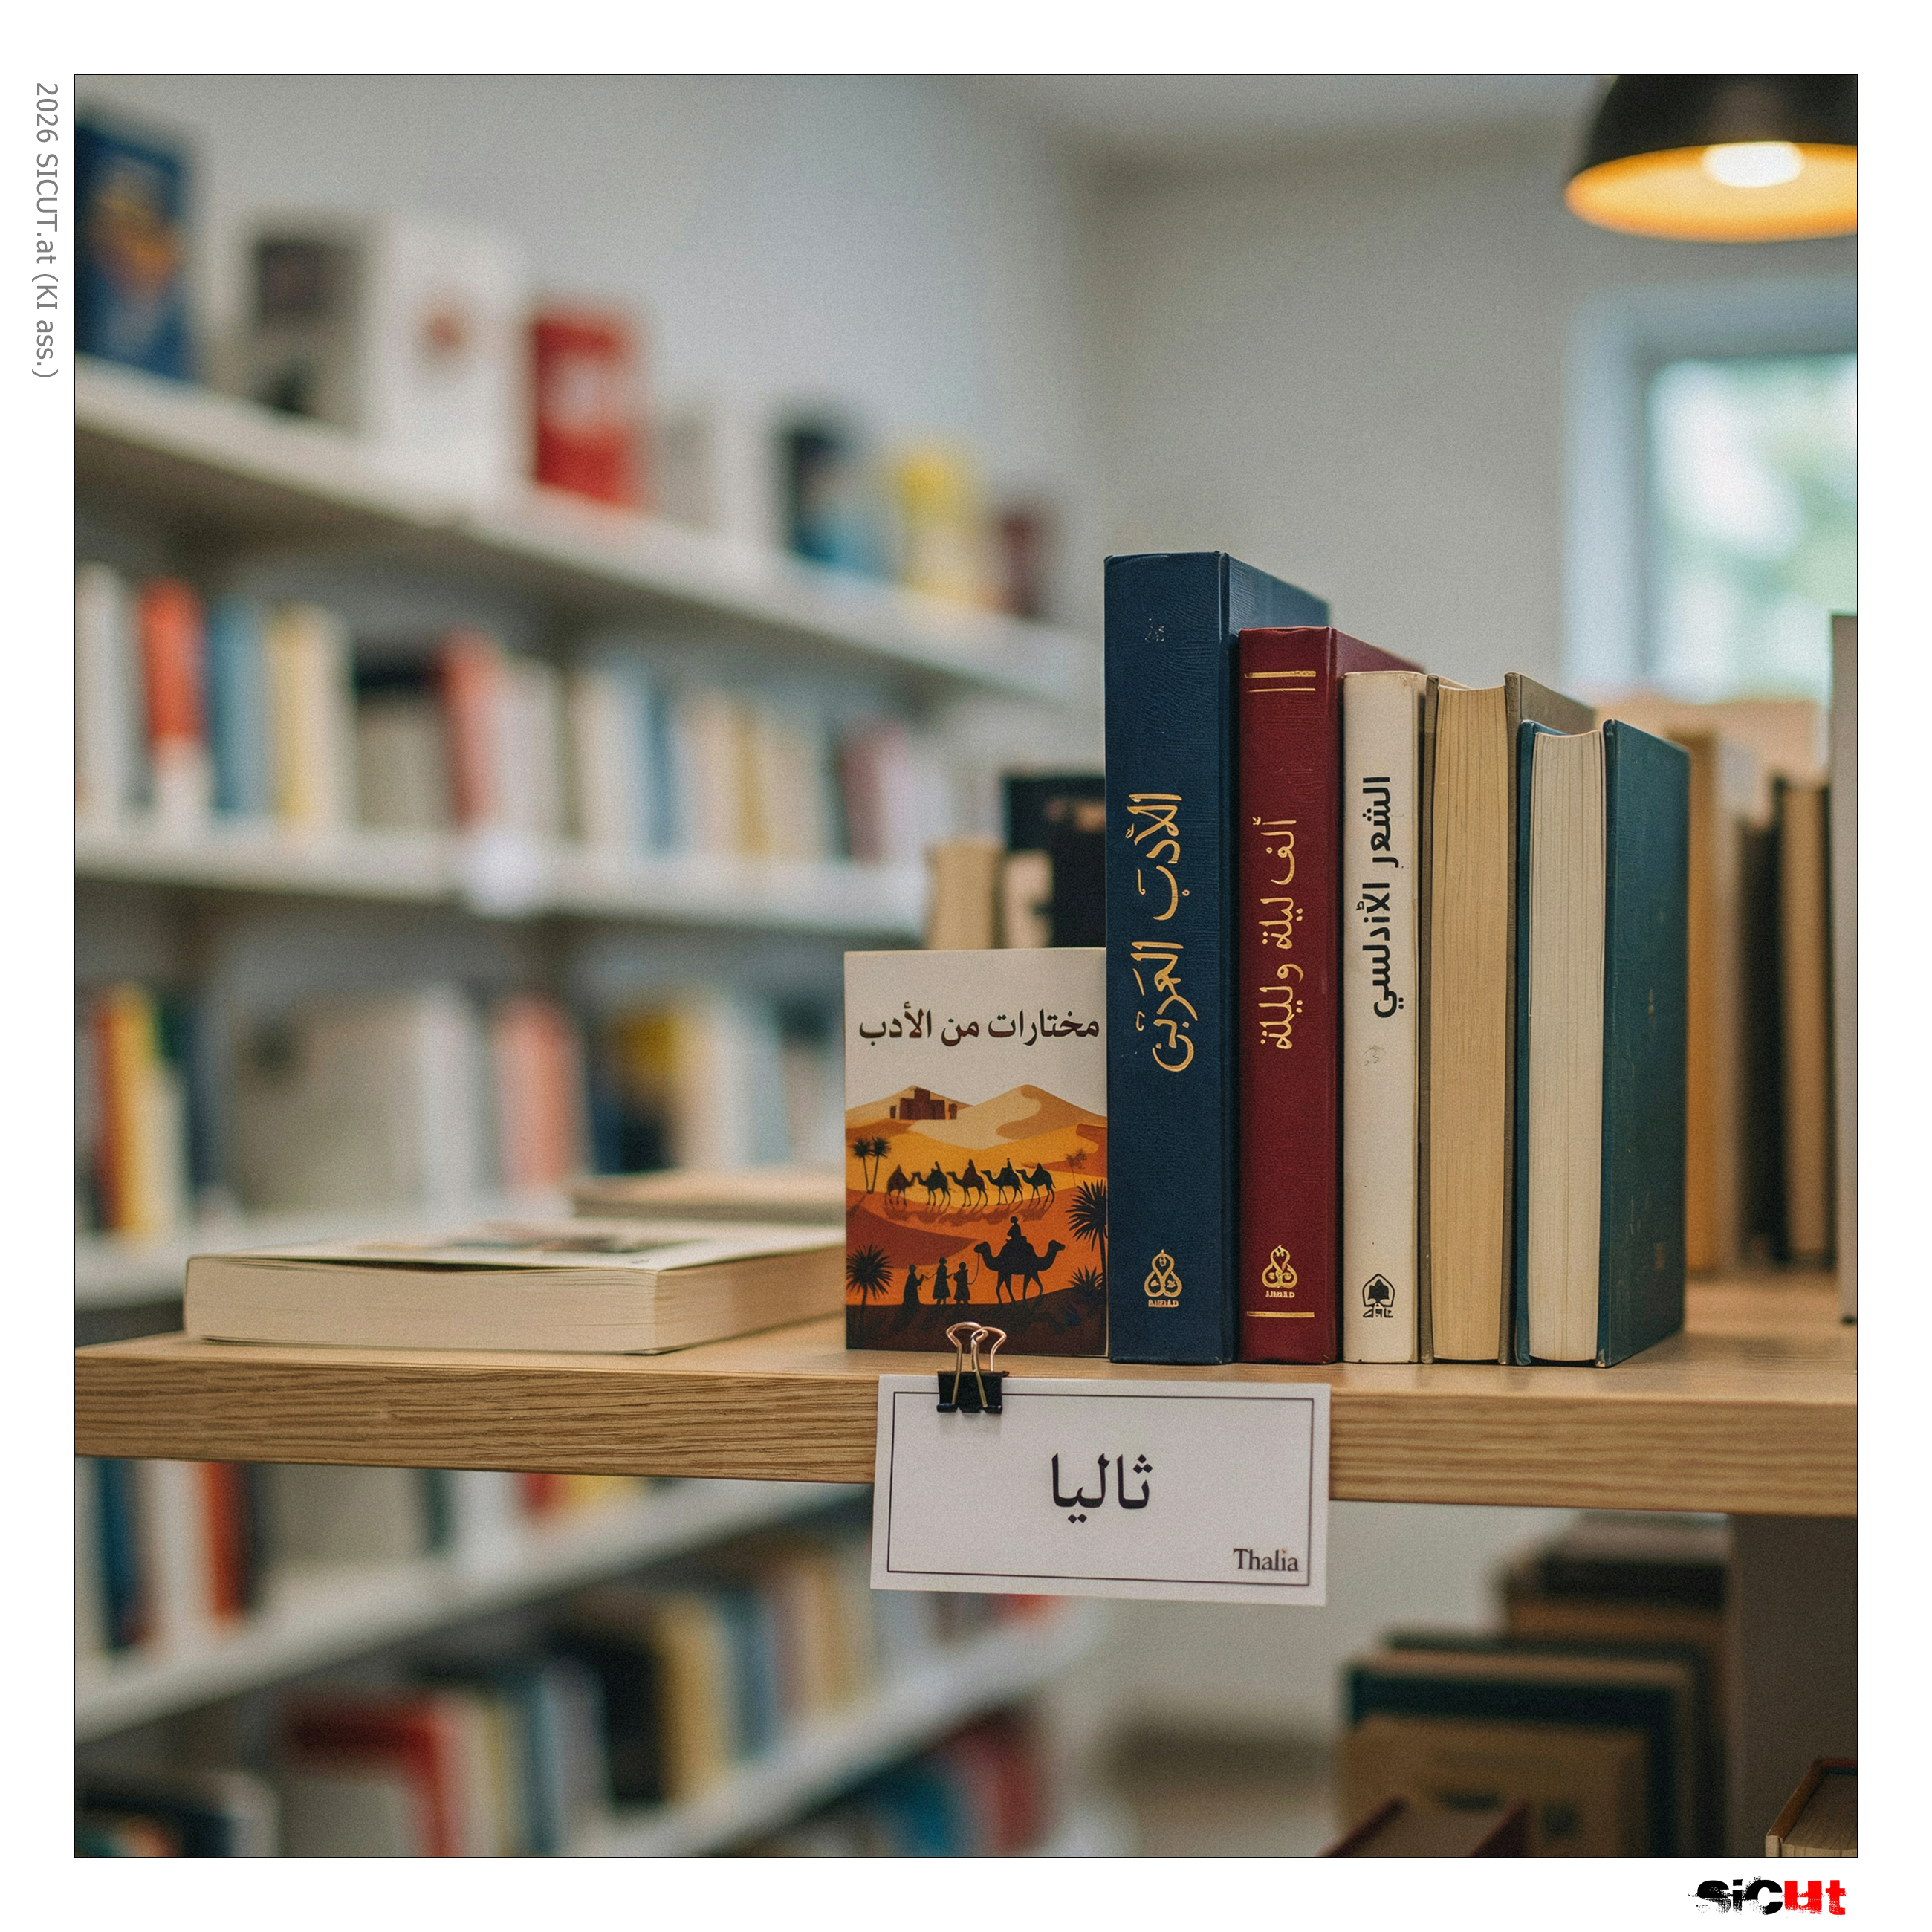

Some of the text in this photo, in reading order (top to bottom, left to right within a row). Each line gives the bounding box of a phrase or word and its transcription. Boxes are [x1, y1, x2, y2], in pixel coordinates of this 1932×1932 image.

[1252, 817, 1297, 886] ألف
[1251, 897, 1304, 950] ليلة
[859, 1000, 1100, 1047] مختارات من الأدب
[1051, 1452, 1154, 1524] ثاليا
[1233, 1547, 1300, 1572] Thalia
